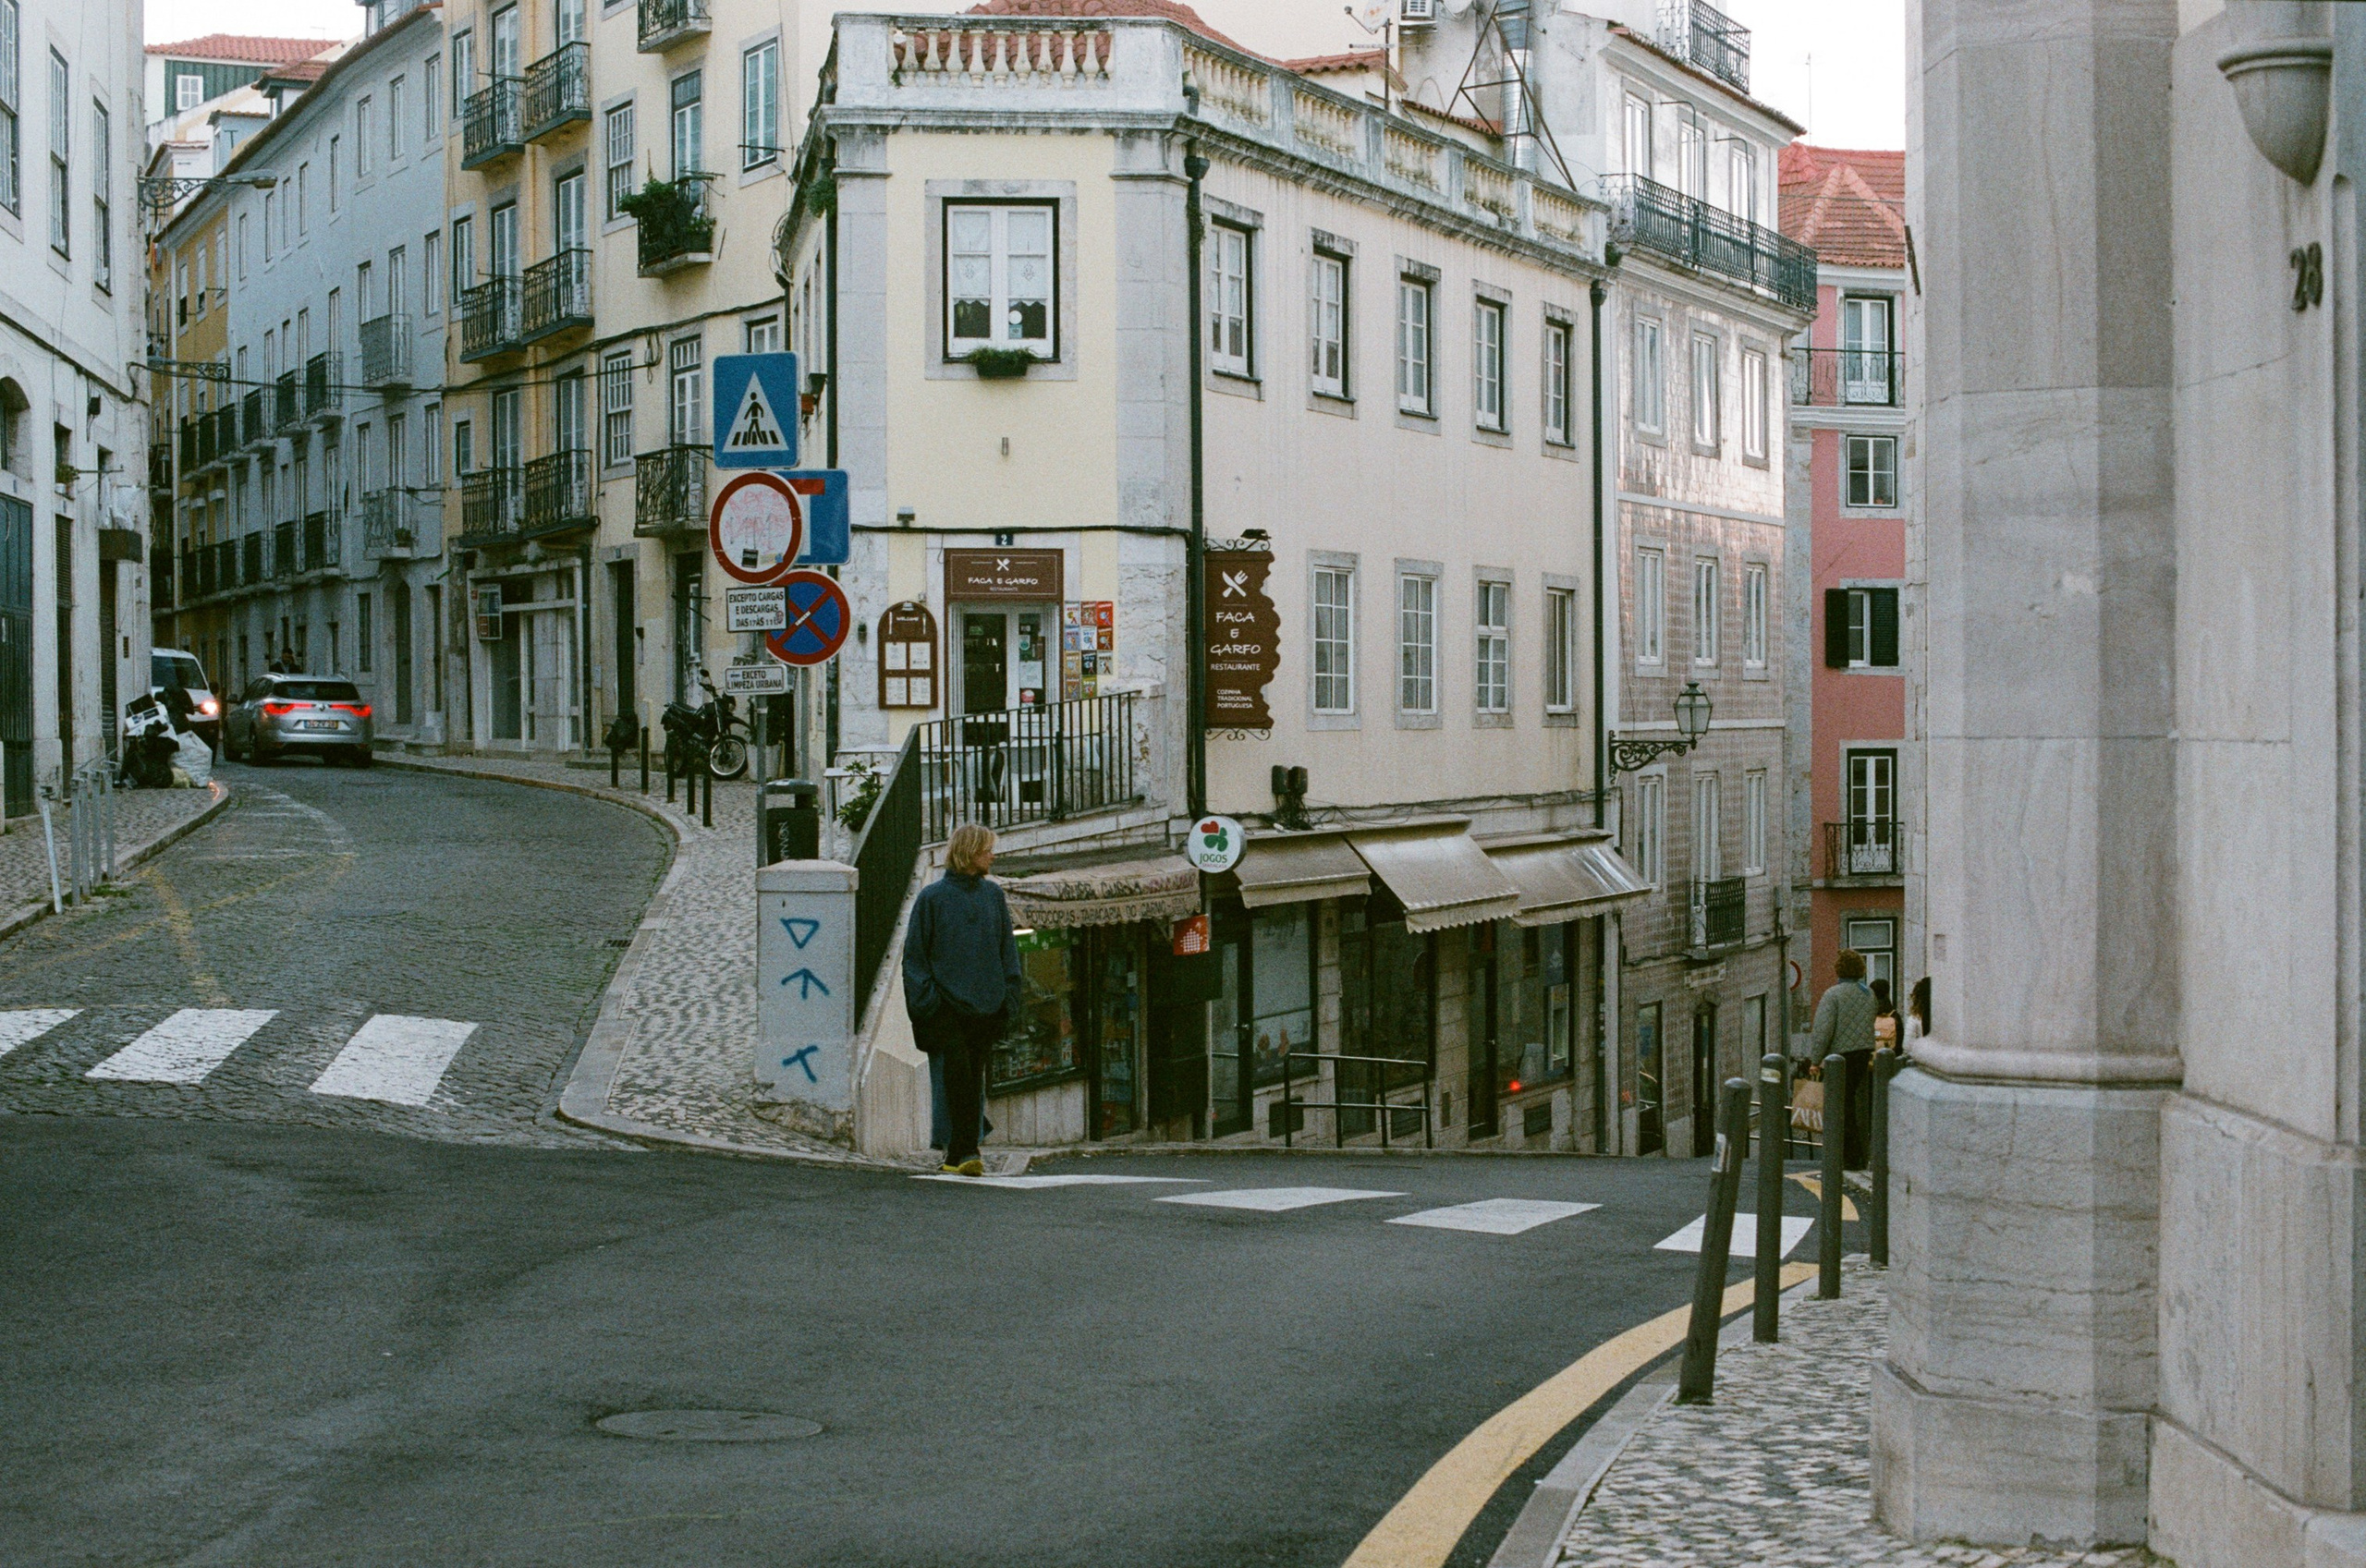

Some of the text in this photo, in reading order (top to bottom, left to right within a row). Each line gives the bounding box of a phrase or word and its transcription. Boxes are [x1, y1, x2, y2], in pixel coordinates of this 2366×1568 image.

[2289, 242, 2324, 312] 28
[1001, 534, 1008, 546] 2
[1005, 577, 1039, 586] GARFO
[729, 591, 784, 603] EXCEPTO CARGAS
[736, 603, 779, 614] E DESCARGAS
[736, 617, 749, 627] DAS
[1215, 612, 1255, 623] FACA
[1230, 628, 1239, 638] E
[1210, 644, 1262, 656] GARFO
[742, 671, 766, 680] EXCETO
[727, 679, 782, 690] LIMPEZA URBANA
[1199, 853, 1228, 865] JOGOS
